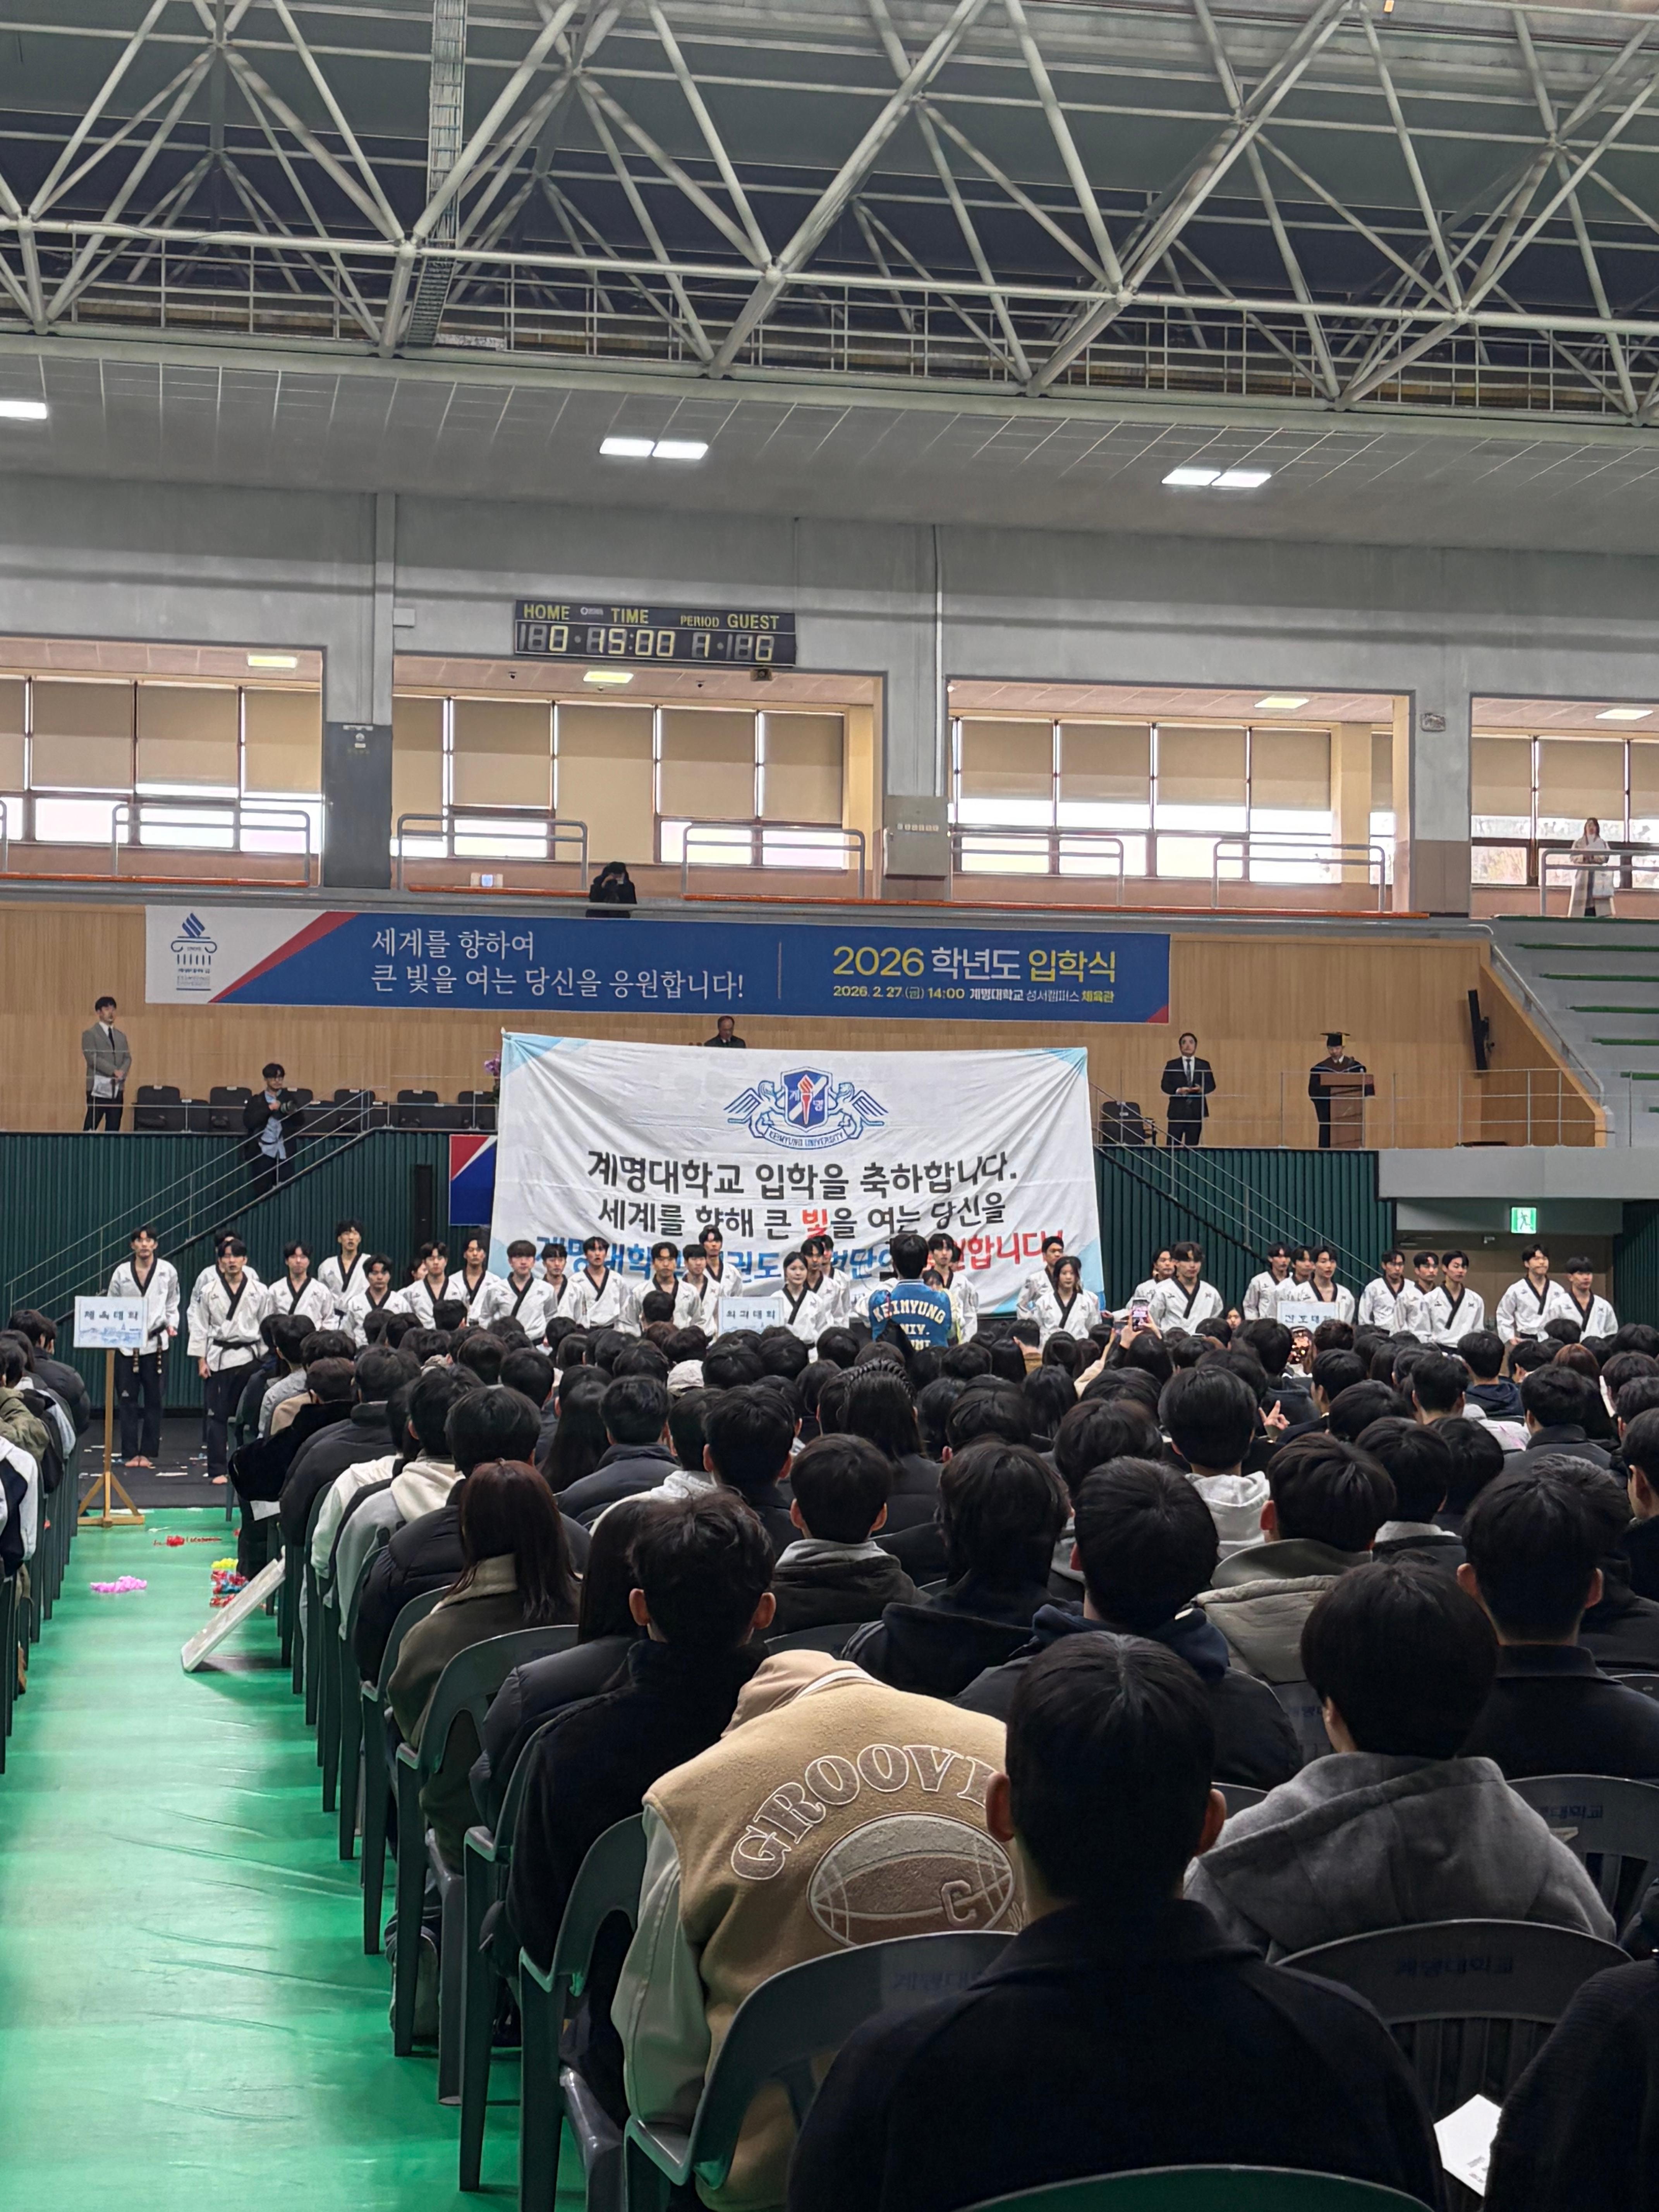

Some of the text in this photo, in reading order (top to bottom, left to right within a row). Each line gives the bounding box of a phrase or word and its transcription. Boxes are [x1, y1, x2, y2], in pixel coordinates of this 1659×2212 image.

[524, 603, 570, 620] HOME
[611, 608, 649, 624] TIME
[680, 615, 720, 628] PERIOD
[727, 613, 780, 630] GUEST
[371, 928, 534, 961] 세계를 향하여
[833, 946, 1116, 983] 2026 학년도 입학식
[371, 964, 744, 1000] 큰 빛을 여는 당신을 응원합니다!
[833, 986, 870, 997] 2026.
[928, 988, 965, 999] 14:00
[970, 988, 1024, 1001] 계명대학교
[588, 1151, 1017, 1200] 계명대학교 입학을 축하합니다.
[598, 1192, 1006, 1240] 세계를 향해 큰 빛을 여는 당신을
[719, 1250, 781, 1283] 권도
[873, 1299, 946, 1324] KEIMYUNG
[900, 1323, 930, 1335] NIV.
[939, 1880, 977, 1927] C
